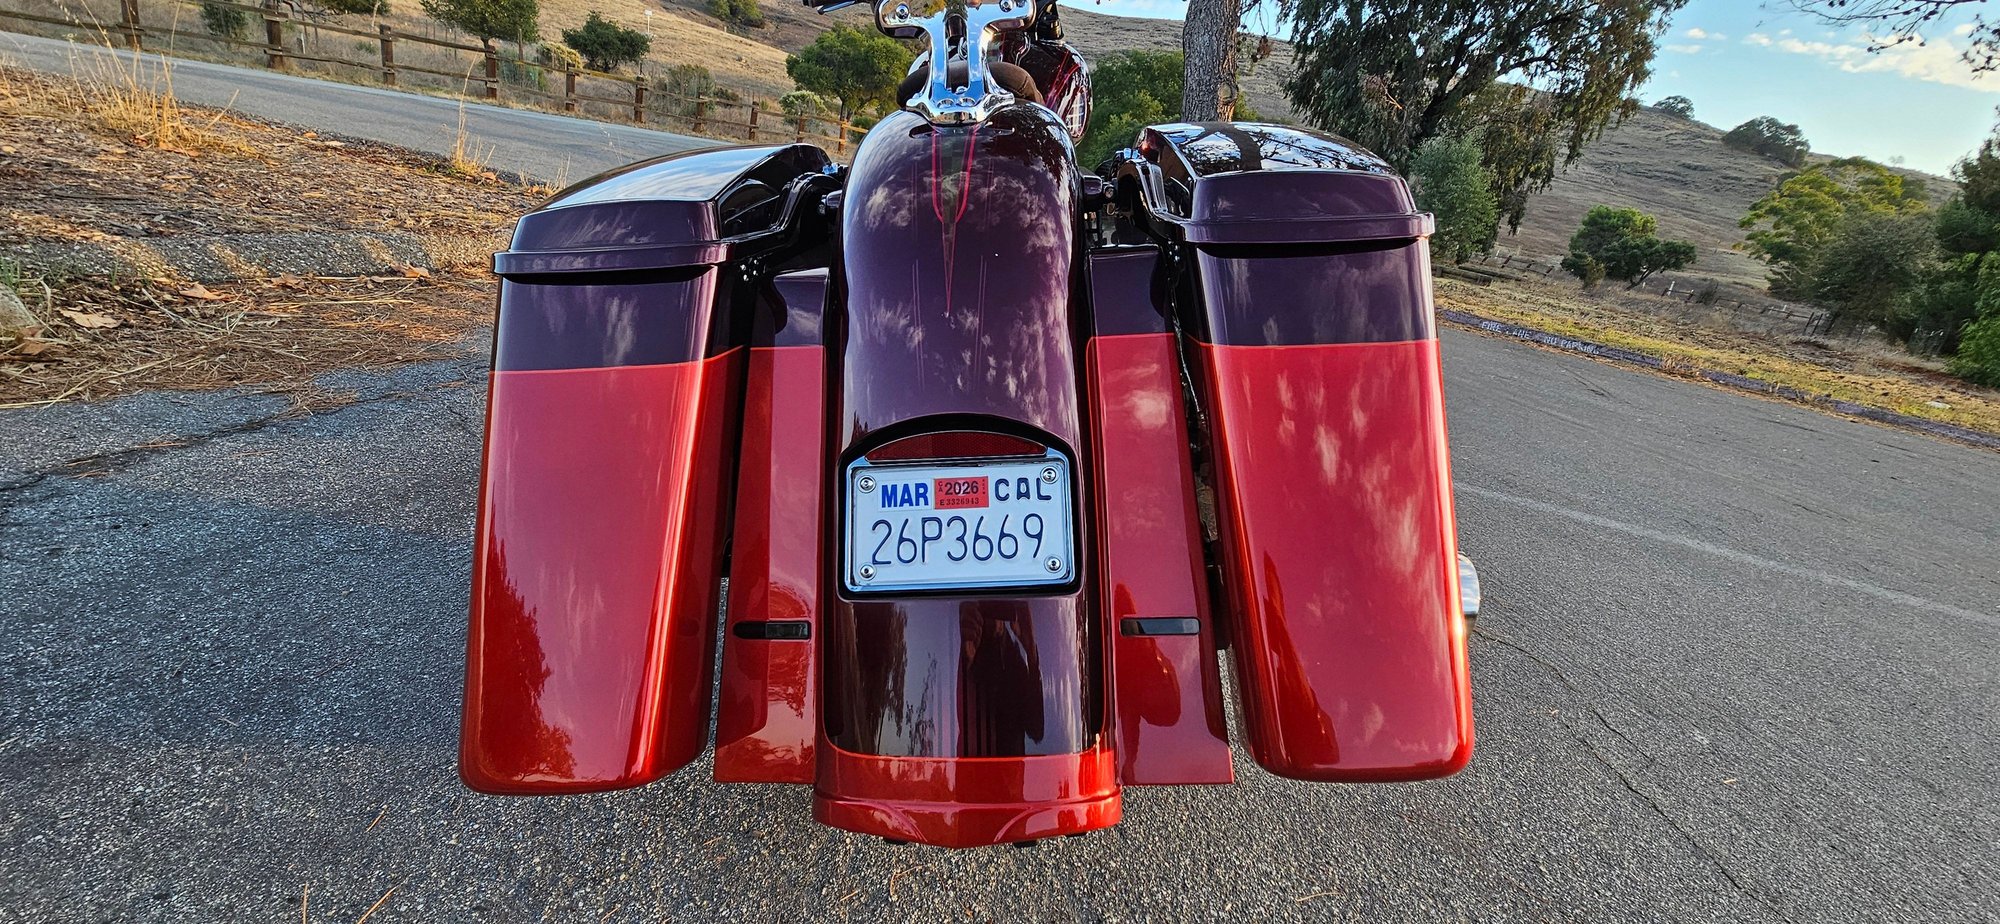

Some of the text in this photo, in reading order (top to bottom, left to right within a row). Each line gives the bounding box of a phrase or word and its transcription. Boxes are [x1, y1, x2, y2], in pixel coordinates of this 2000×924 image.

[1481, 321, 1502, 333] FIRE
[881, 482, 929, 508] MAR
[944, 480, 979, 496] 2026
[994, 477, 1052, 502] CAL
[871, 513, 1045, 565] 26P3669
